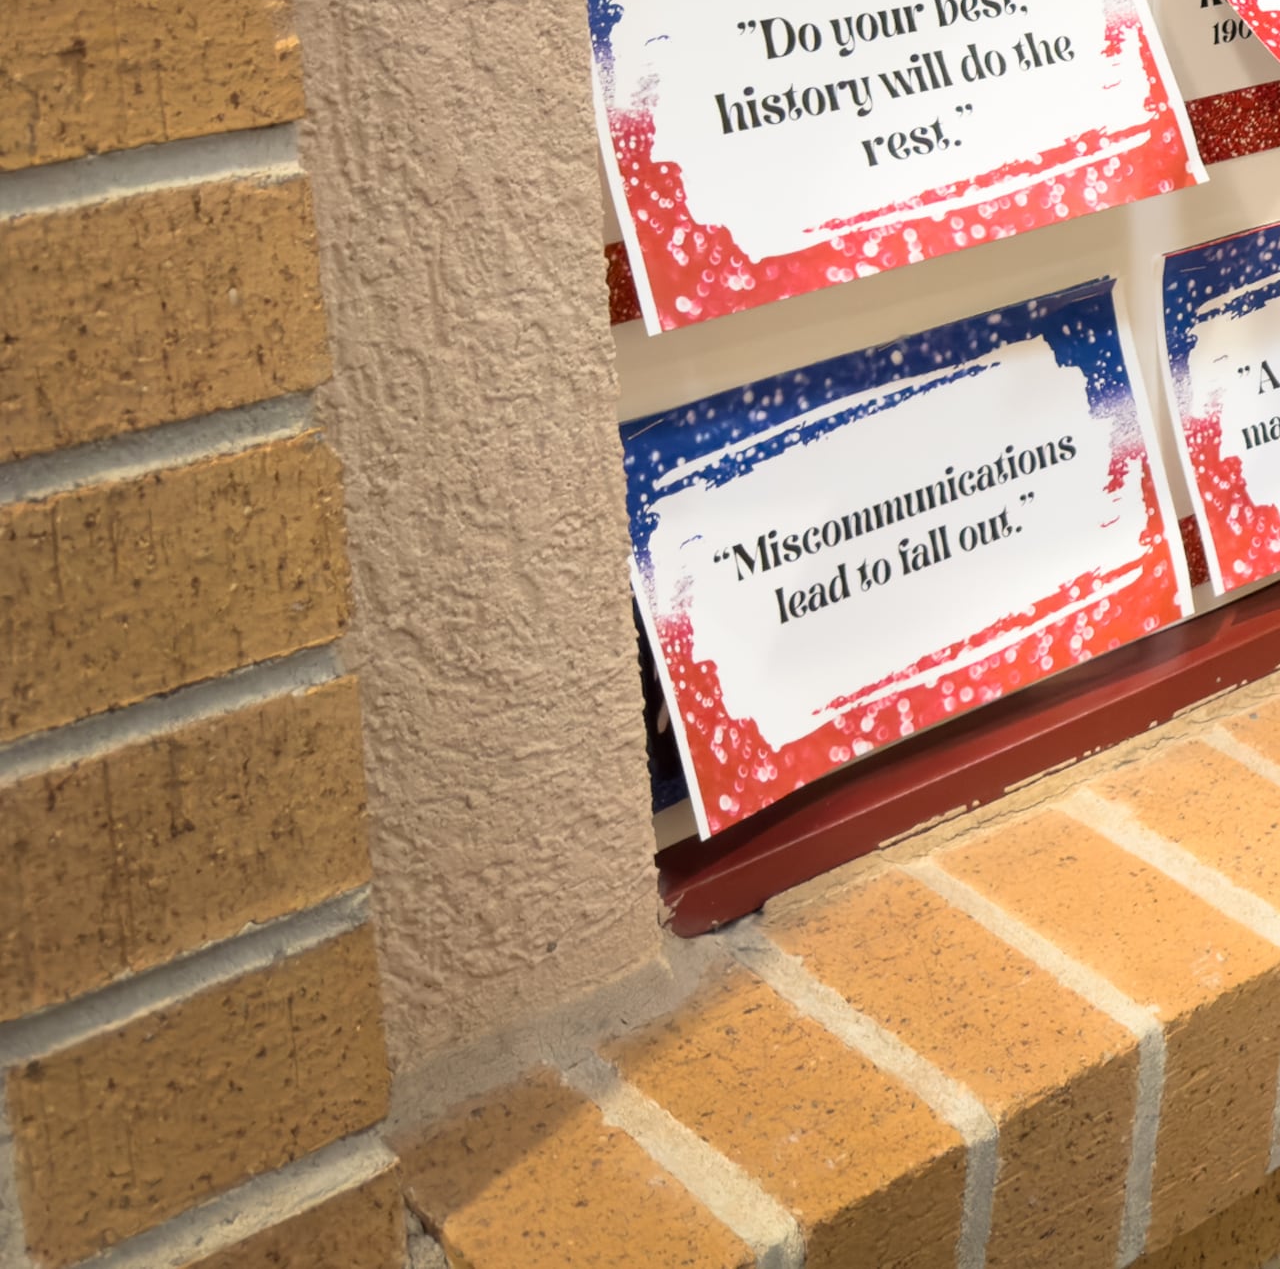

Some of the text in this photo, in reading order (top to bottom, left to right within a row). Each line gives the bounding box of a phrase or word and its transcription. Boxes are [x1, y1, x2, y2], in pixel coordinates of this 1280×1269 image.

[829, 3, 925, 58] your
[1211, 18, 1254, 45] 190
[714, 32, 1076, 135] history will do the
[774, 562, 852, 625] lead
[856, 555, 893, 590] to
[898, 524, 953, 577] fall
